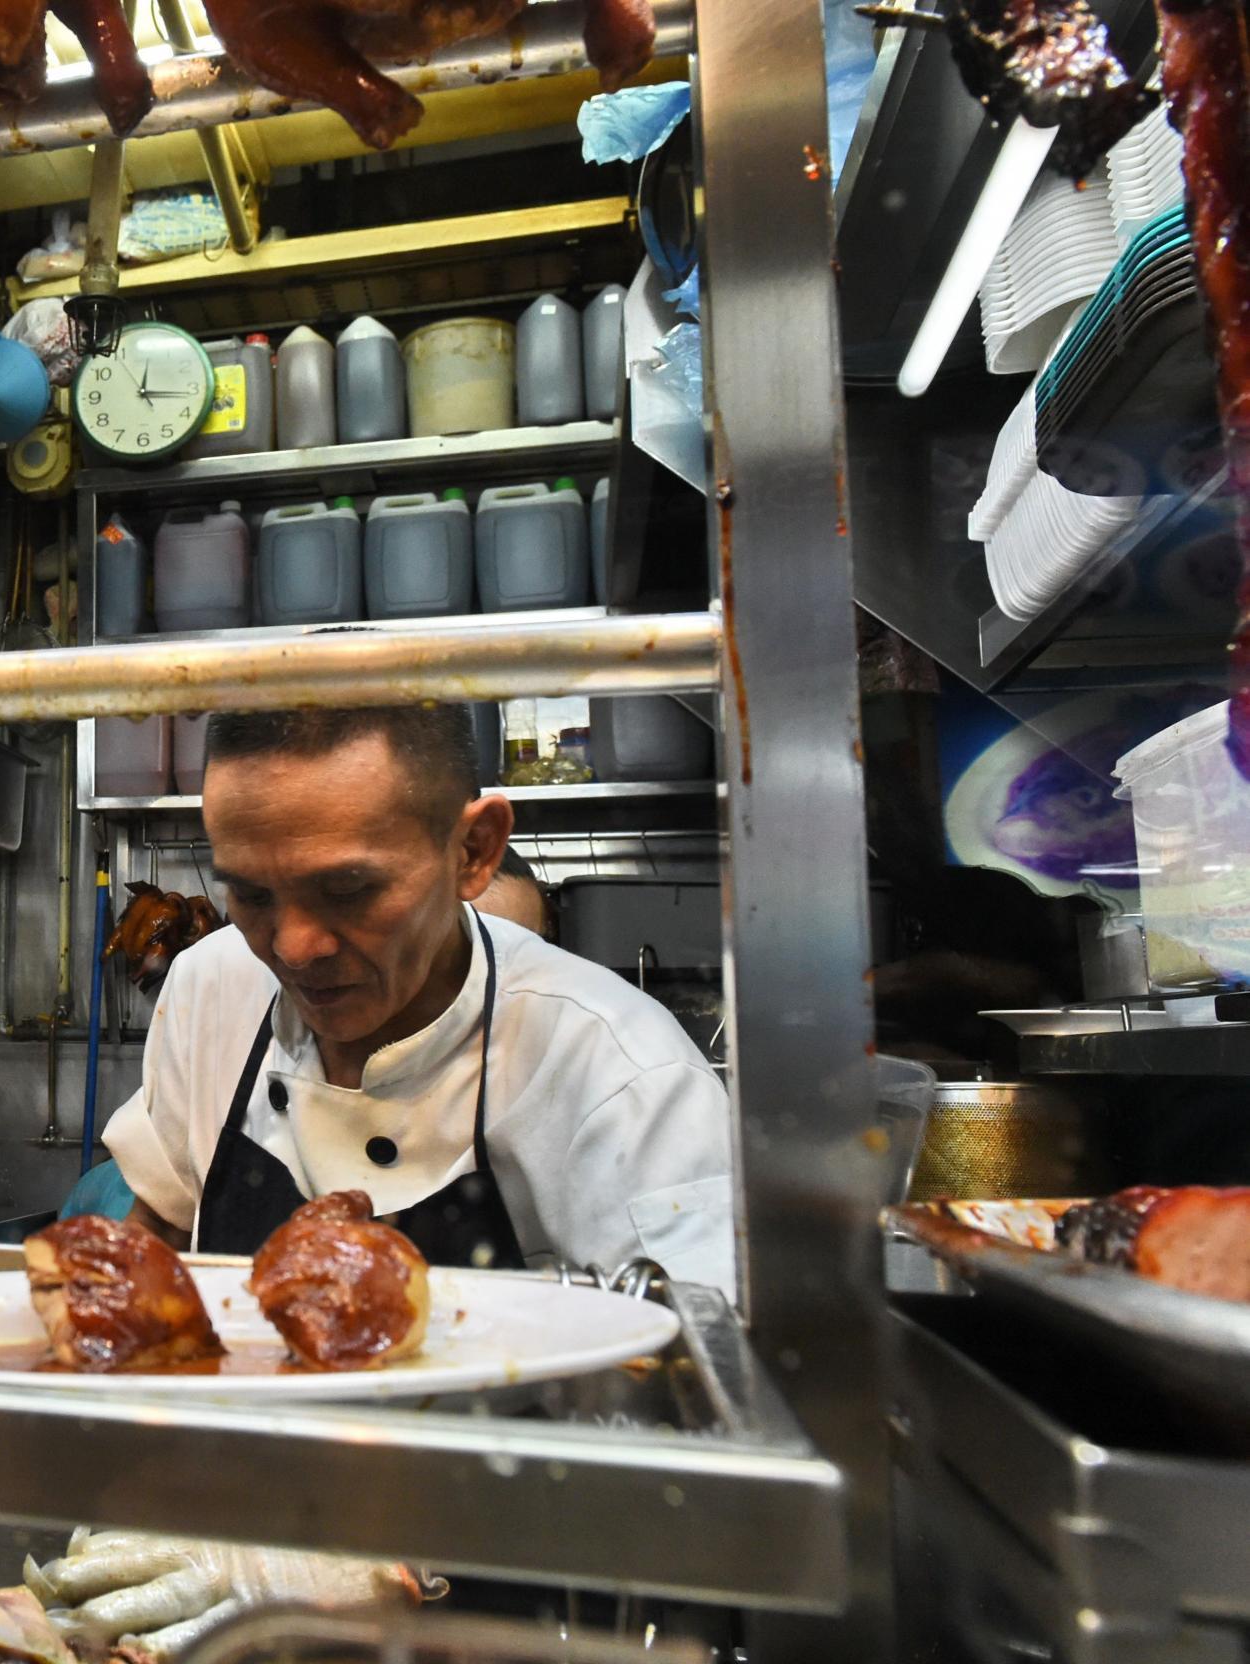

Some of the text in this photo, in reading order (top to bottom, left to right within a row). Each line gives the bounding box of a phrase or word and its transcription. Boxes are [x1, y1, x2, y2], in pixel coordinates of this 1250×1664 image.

[93, 367, 112, 381] 10
[179, 360, 192, 374] 2
[187, 382, 199, 396] 3
[88, 391, 102, 405] 9
[95, 413, 109, 427] 8
[178, 406, 191, 420] 4
[113, 429, 125, 443] 7
[161, 424, 174, 438] 5
[136, 433, 150, 447] 6
